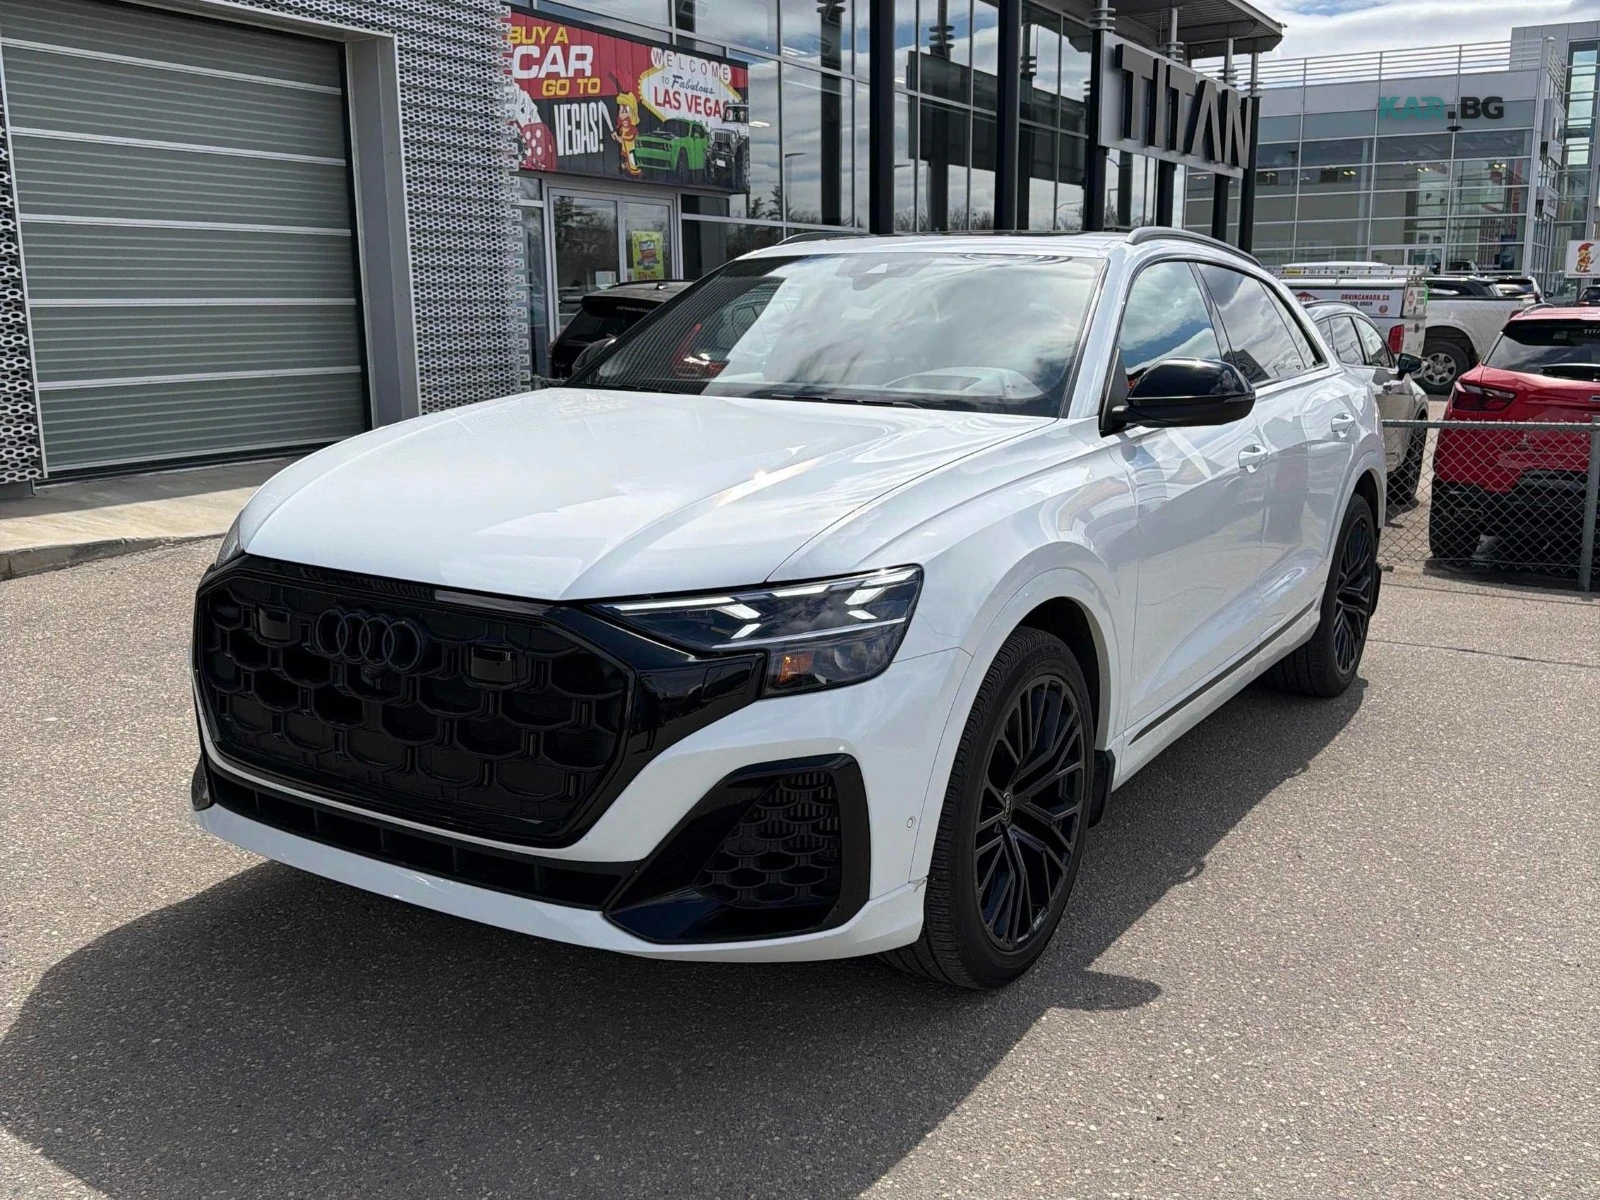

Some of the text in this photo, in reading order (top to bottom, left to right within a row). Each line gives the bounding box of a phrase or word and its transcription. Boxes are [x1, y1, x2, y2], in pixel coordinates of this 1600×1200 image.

[507, 26, 569, 44] BUY A
[512, 45, 594, 79] CAR
[653, 51, 728, 80] WELCOME
[542, 78, 601, 96] GO TO
[662, 74, 716, 95] TO Fabulous
[654, 86, 681, 110] LAS
[1115, 44, 1251, 169] TITAN
[554, 102, 604, 157] VEGAS!
